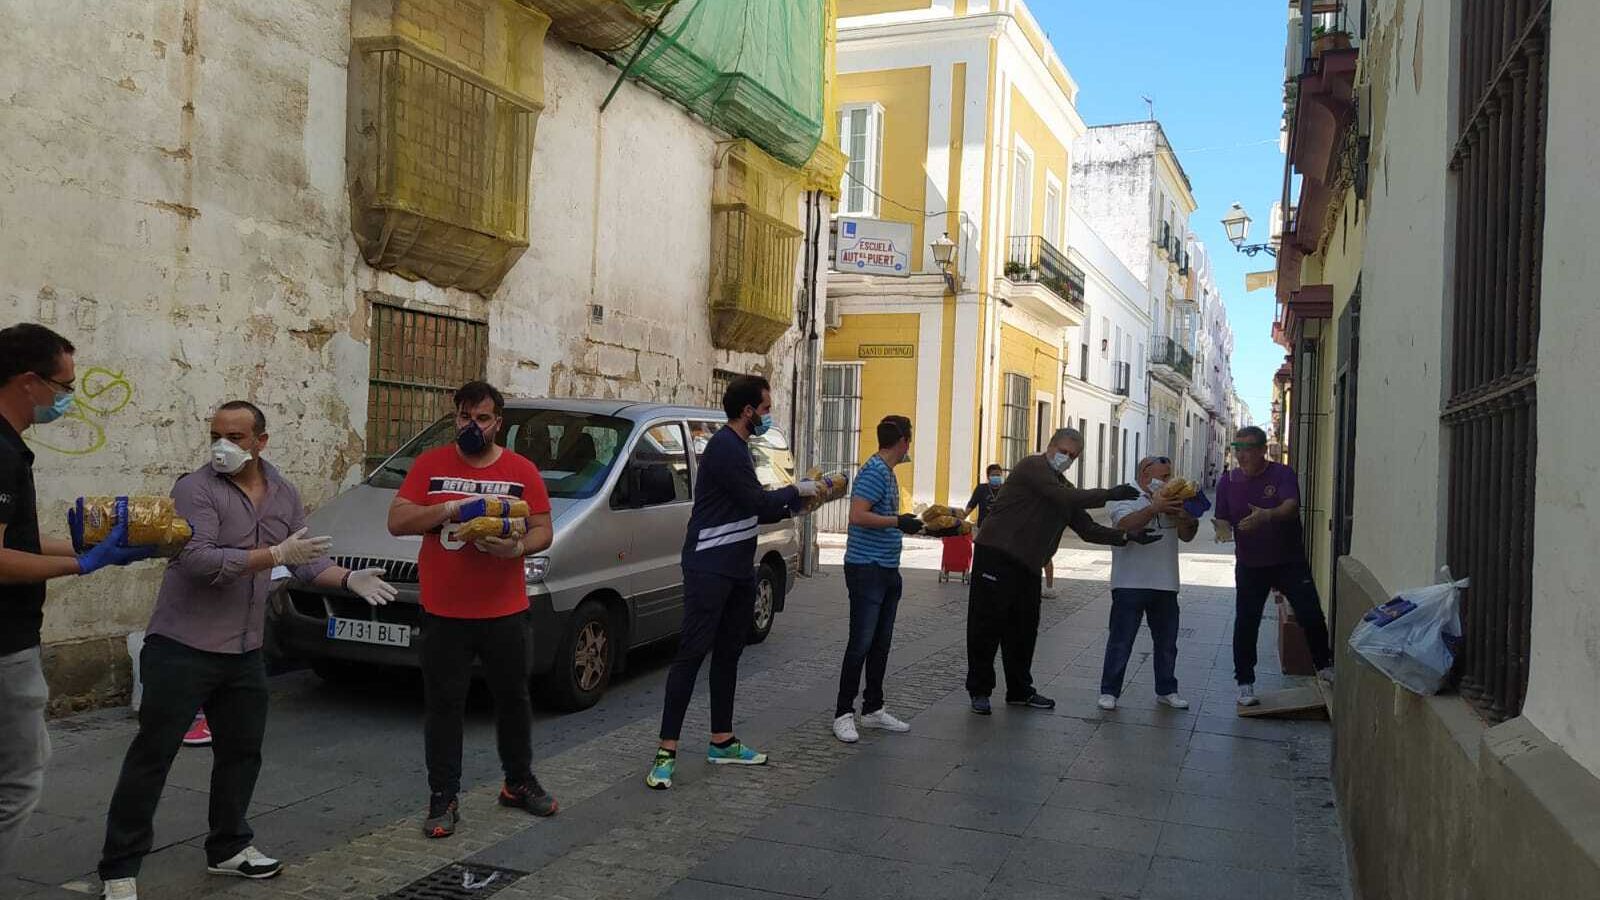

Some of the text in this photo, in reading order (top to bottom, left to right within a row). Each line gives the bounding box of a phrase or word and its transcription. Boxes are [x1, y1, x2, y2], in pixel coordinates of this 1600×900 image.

[860, 241, 893, 252] ESCUELA
[861, 346, 912, 356] SANTO DOMINGO
[442, 480, 510, 495] RETRO TEAM
[337, 620, 372, 640] 7131
[378, 625, 407, 643] BLT
